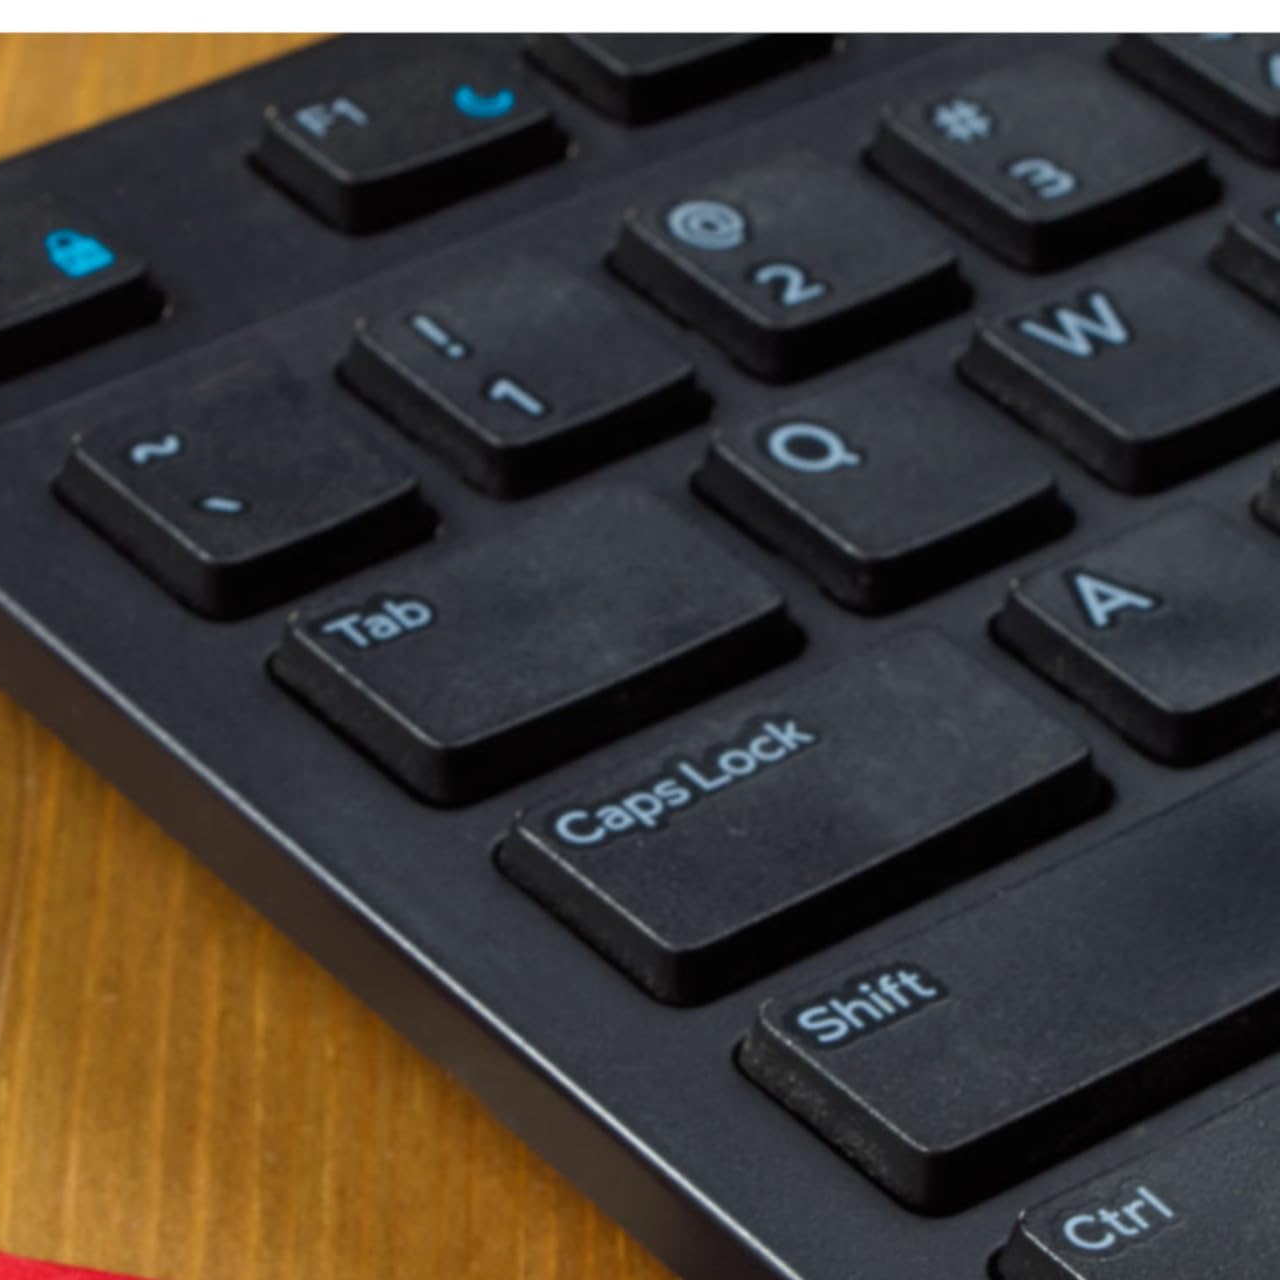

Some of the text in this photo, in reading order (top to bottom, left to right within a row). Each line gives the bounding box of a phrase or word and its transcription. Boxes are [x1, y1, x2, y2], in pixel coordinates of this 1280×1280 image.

[295, 98, 370, 137] F1
[933, 100, 991, 142] #
[1010, 157, 1077, 199] 3
[666, 200, 747, 250] @
[754, 264, 827, 306] 2
[410, 314, 465, 359] !
[1022, 292, 1129, 358] W
[490, 377, 545, 417] 1
[767, 423, 861, 473] Q
[323, 595, 434, 650] Tab
[1070, 570, 1154, 627] A
[553, 717, 815, 848] Caps Lock
[797, 966, 938, 1047] Shift
[1061, 1185, 1176, 1252] Ctrl
